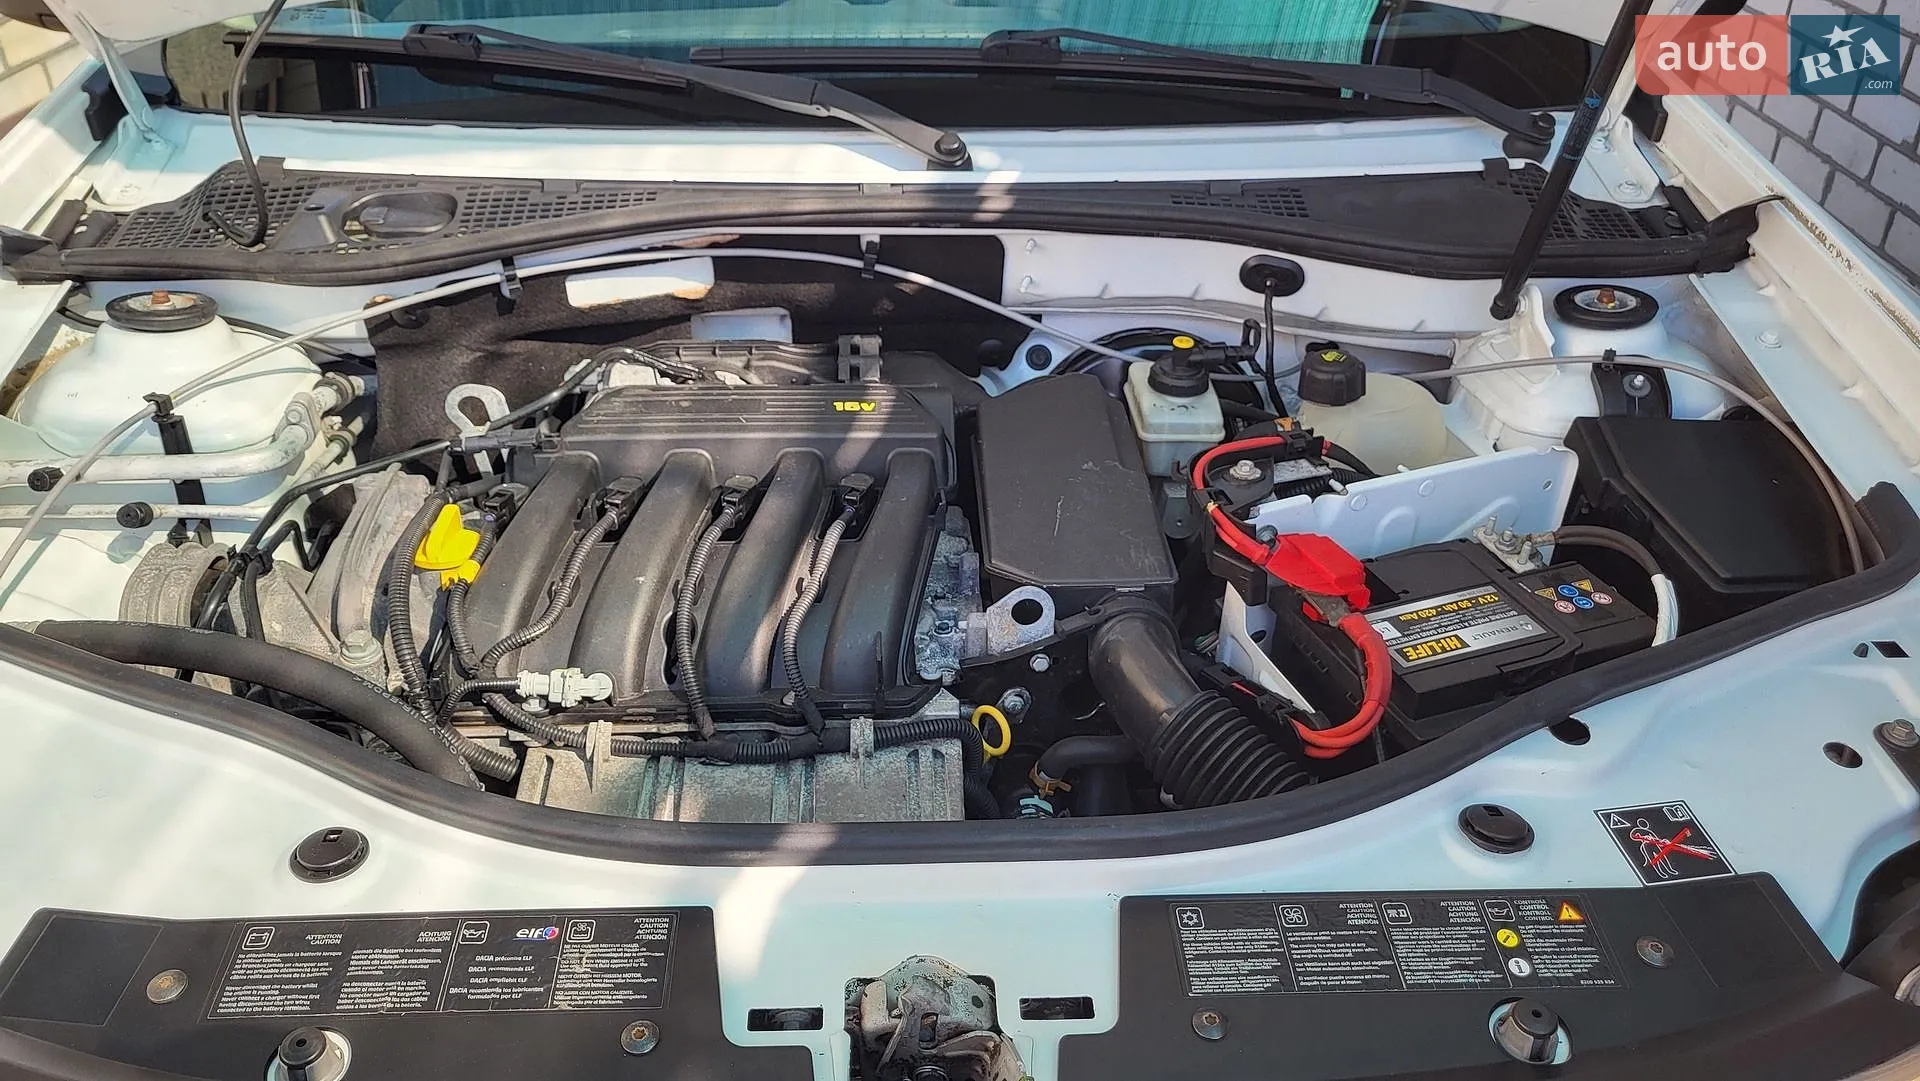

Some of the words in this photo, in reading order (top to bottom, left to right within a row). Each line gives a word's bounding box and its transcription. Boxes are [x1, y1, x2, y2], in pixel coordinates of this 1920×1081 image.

[1457, 600, 1472, 609] 50
[1477, 594, 1499, 605] 12V
[1442, 602, 1458, 612] Ah
[1418, 608, 1437, 618] 420
[1471, 625, 1518, 640] RENAULT
[516, 928, 544, 938] elf
